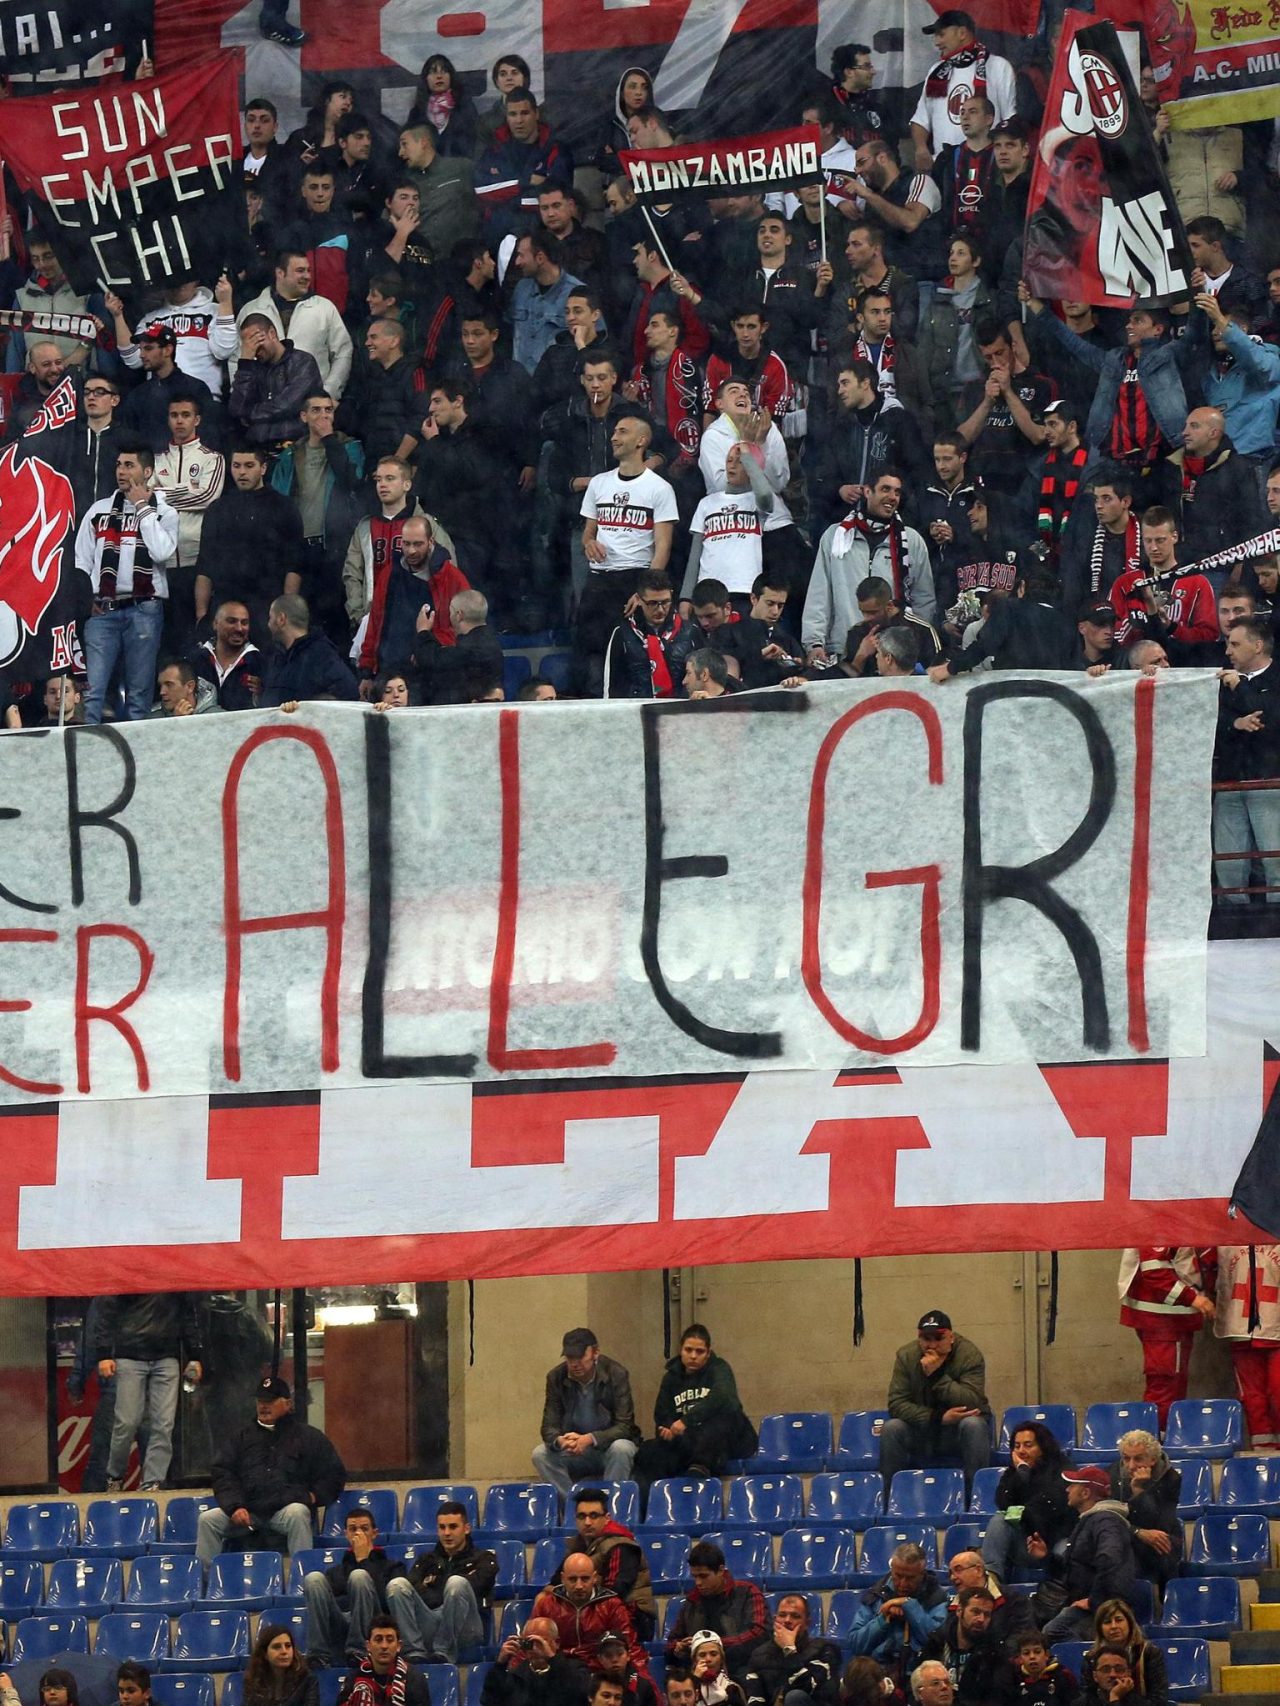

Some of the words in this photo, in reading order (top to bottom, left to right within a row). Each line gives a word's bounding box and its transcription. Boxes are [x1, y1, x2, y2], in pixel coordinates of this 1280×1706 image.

[1193, 60, 1240, 83] A.C.
[51, 88, 168, 161] SUN
[1099, 114, 1122, 129] 1899
[628, 141, 819, 194] MONZAMBANO
[958, 205, 981, 214] OPEL
[90, 215, 191, 285] CHI
[32, 311, 97, 339] ODIO
[623, 509, 648, 526] SUD
[736, 513, 757, 530] SUD
[221, 676, 1157, 1083] ALLEGRI
